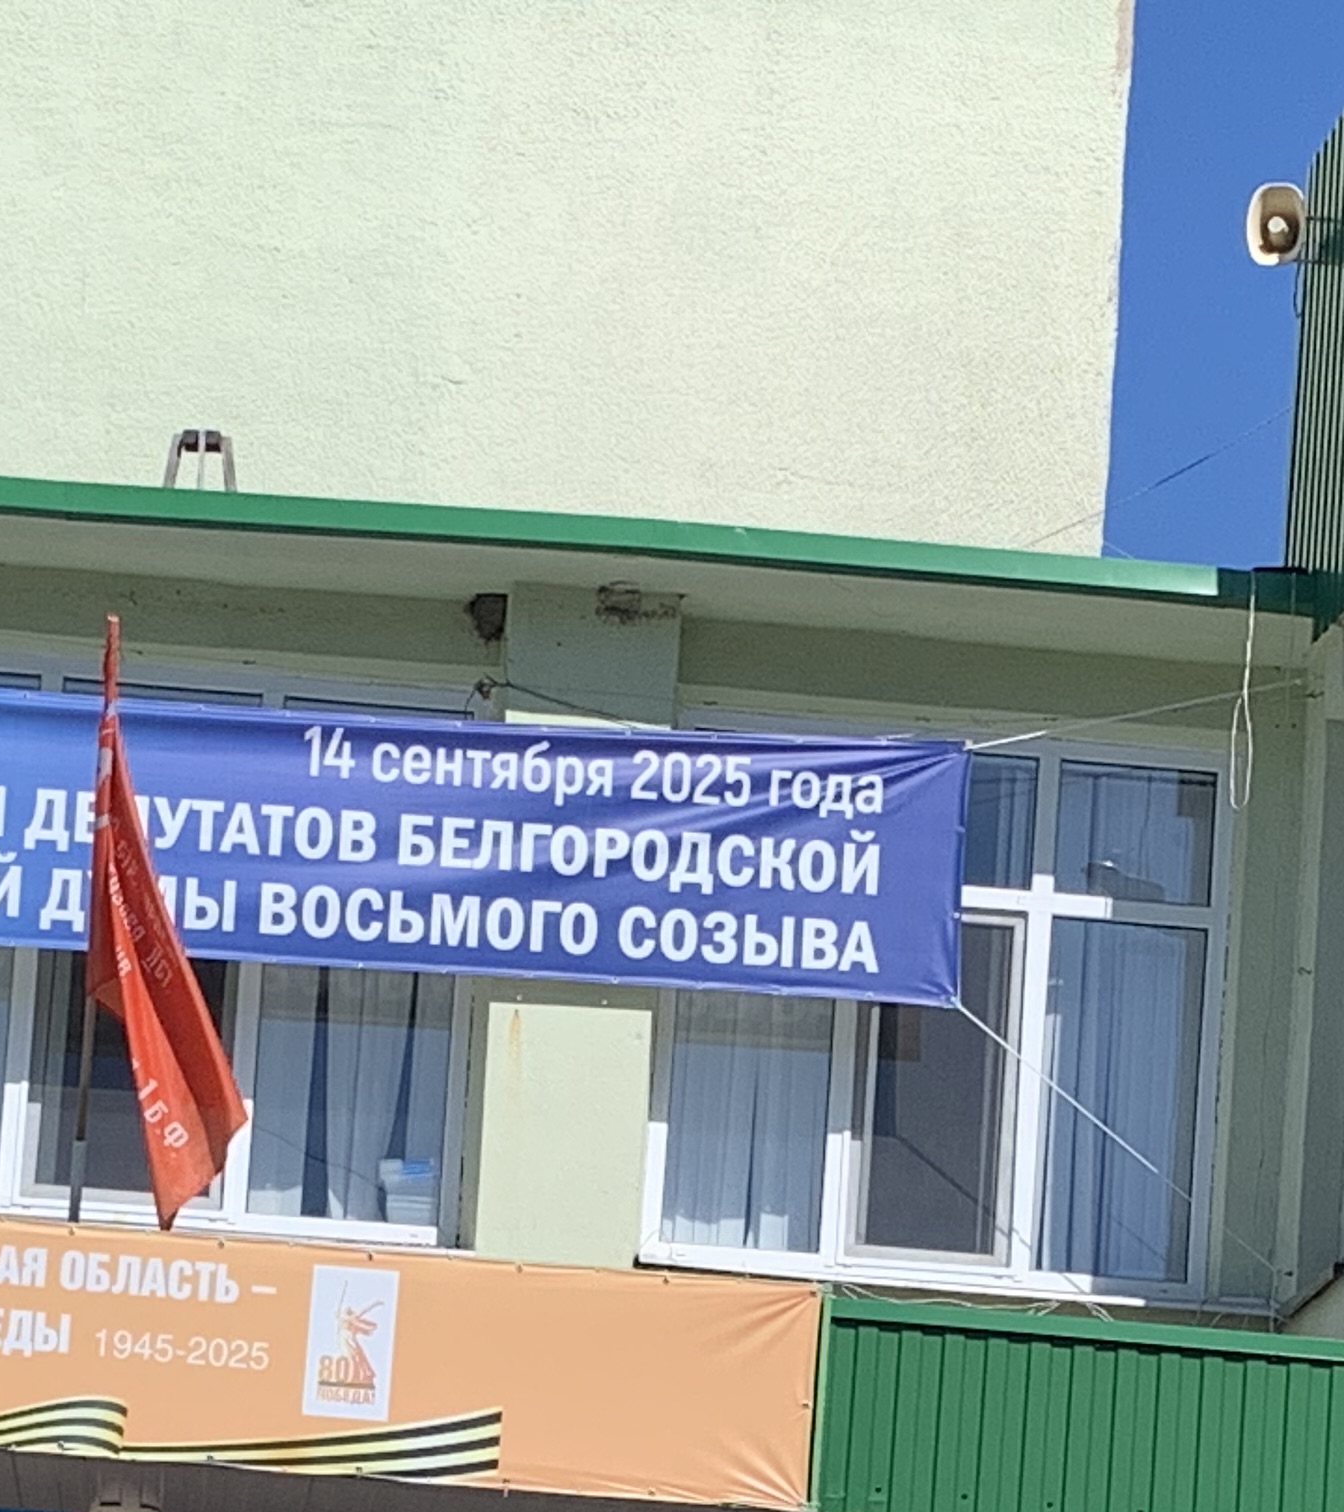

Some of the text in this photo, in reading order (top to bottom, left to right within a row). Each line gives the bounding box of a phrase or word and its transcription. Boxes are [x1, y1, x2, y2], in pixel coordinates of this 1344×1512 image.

[304, 727, 885, 822] 14 сентября 2025 года
[23, 787, 377, 865] ДЕУТАТОВ
[397, 813, 882, 897] БЕЛГОРОДСКОЙ
[257, 882, 600, 960] ВОСЬМОГО
[618, 909, 881, 975] СОЗЫВА
[60, 1250, 240, 1305] ОБЛАСТЬ
[94, 1328, 272, 1372] 1945-2025
